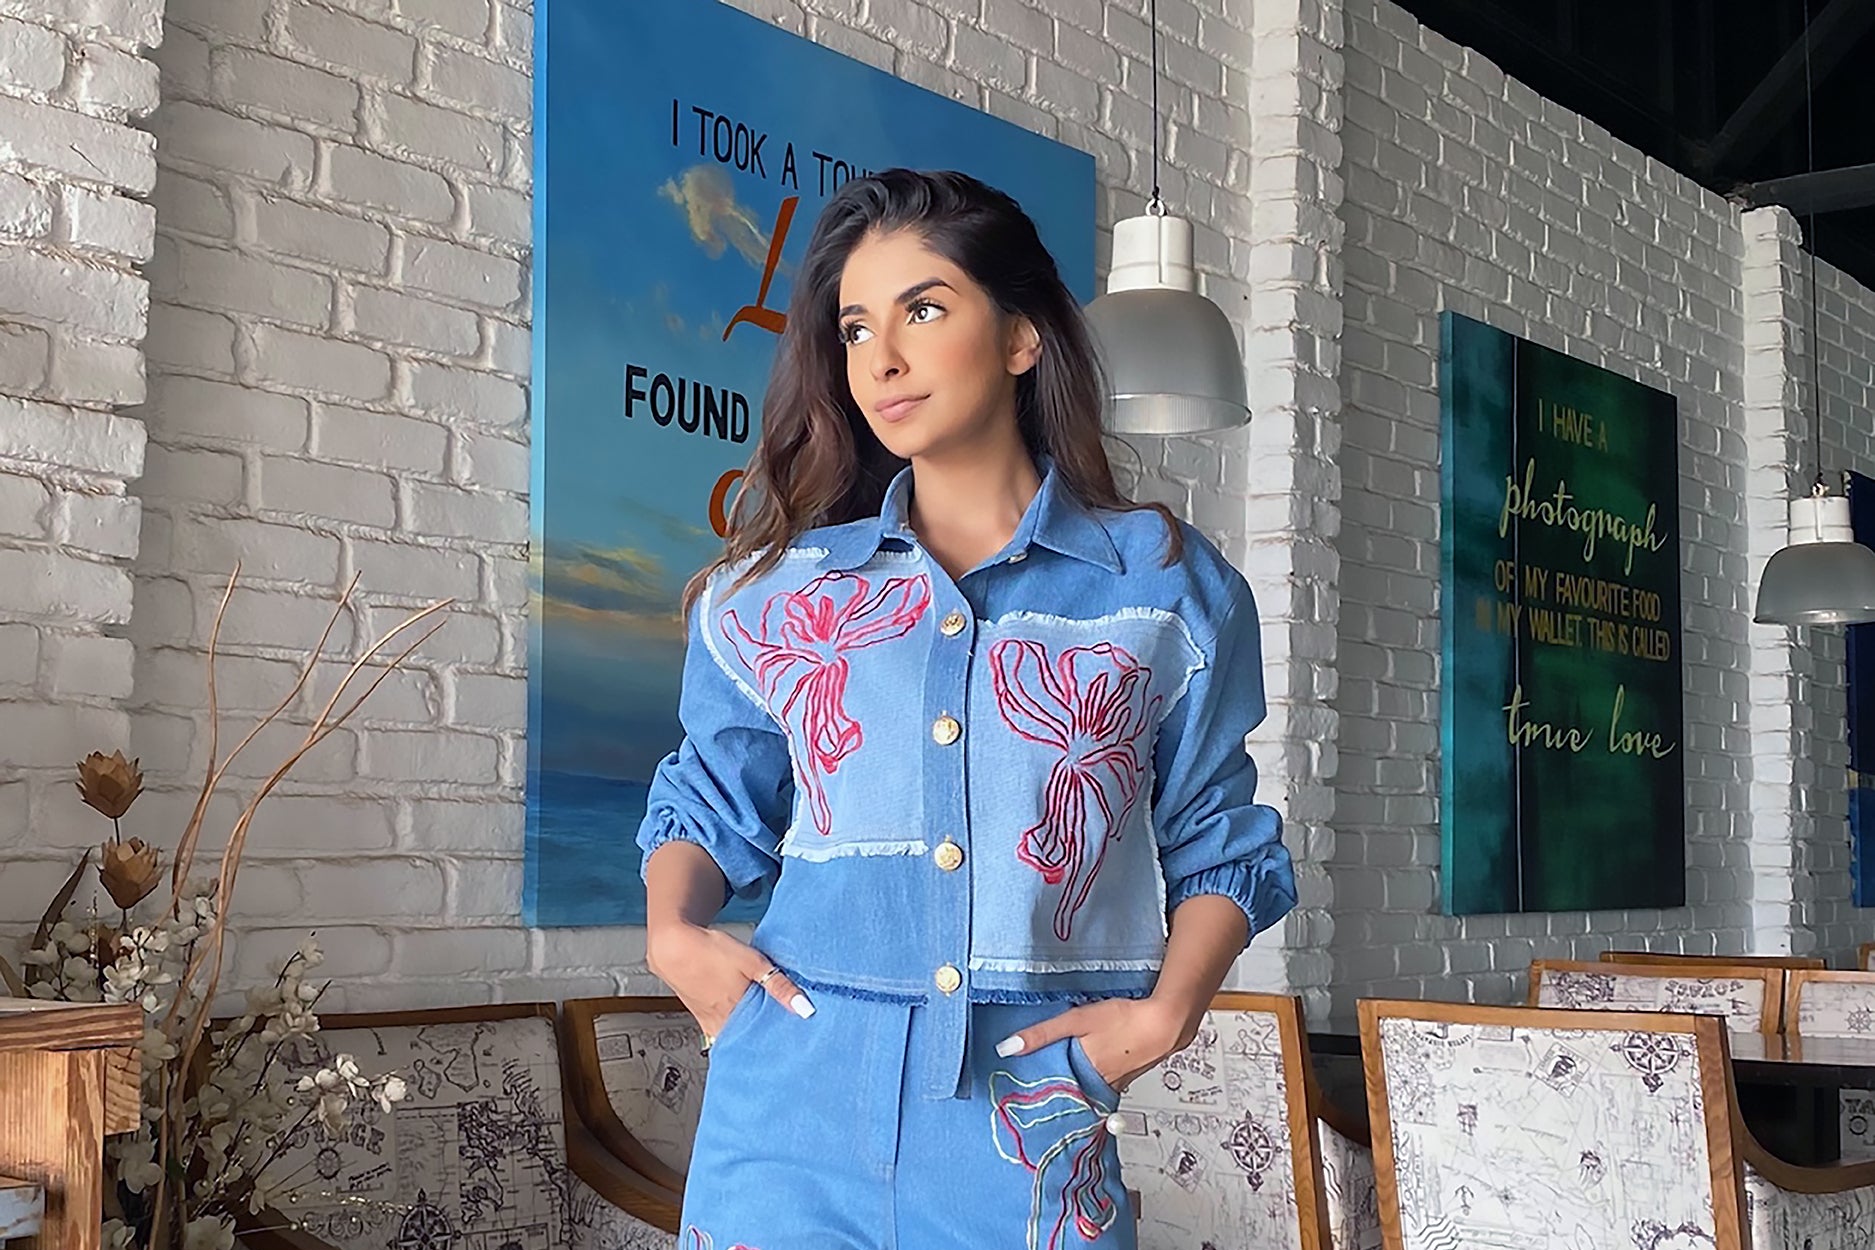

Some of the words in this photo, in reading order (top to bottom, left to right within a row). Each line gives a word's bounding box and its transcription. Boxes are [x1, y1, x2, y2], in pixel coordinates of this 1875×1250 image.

[672, 98, 679, 147] I
[692, 105, 768, 179] TOOK
[781, 142, 799, 190] A
[625, 363, 750, 444] FOUND
[1538, 398, 1544, 433] I
[1553, 403, 1593, 448] HAVE
[1598, 419, 1609, 453] A
[1499, 457, 1669, 577] photograph
[1494, 560, 1515, 594] OF
[1525, 564, 1549, 600] MY
[1556, 571, 1631, 616] FAVOURITE
[1632, 588, 1661, 622] FOOD
[1497, 601, 1523, 640] MY
[1587, 617, 1616, 652] THIS
[1618, 623, 1629, 655] IS
[1632, 626, 1671, 662] CALLED
[1501, 683, 1595, 753] true
[1609, 683, 1676, 759] love
